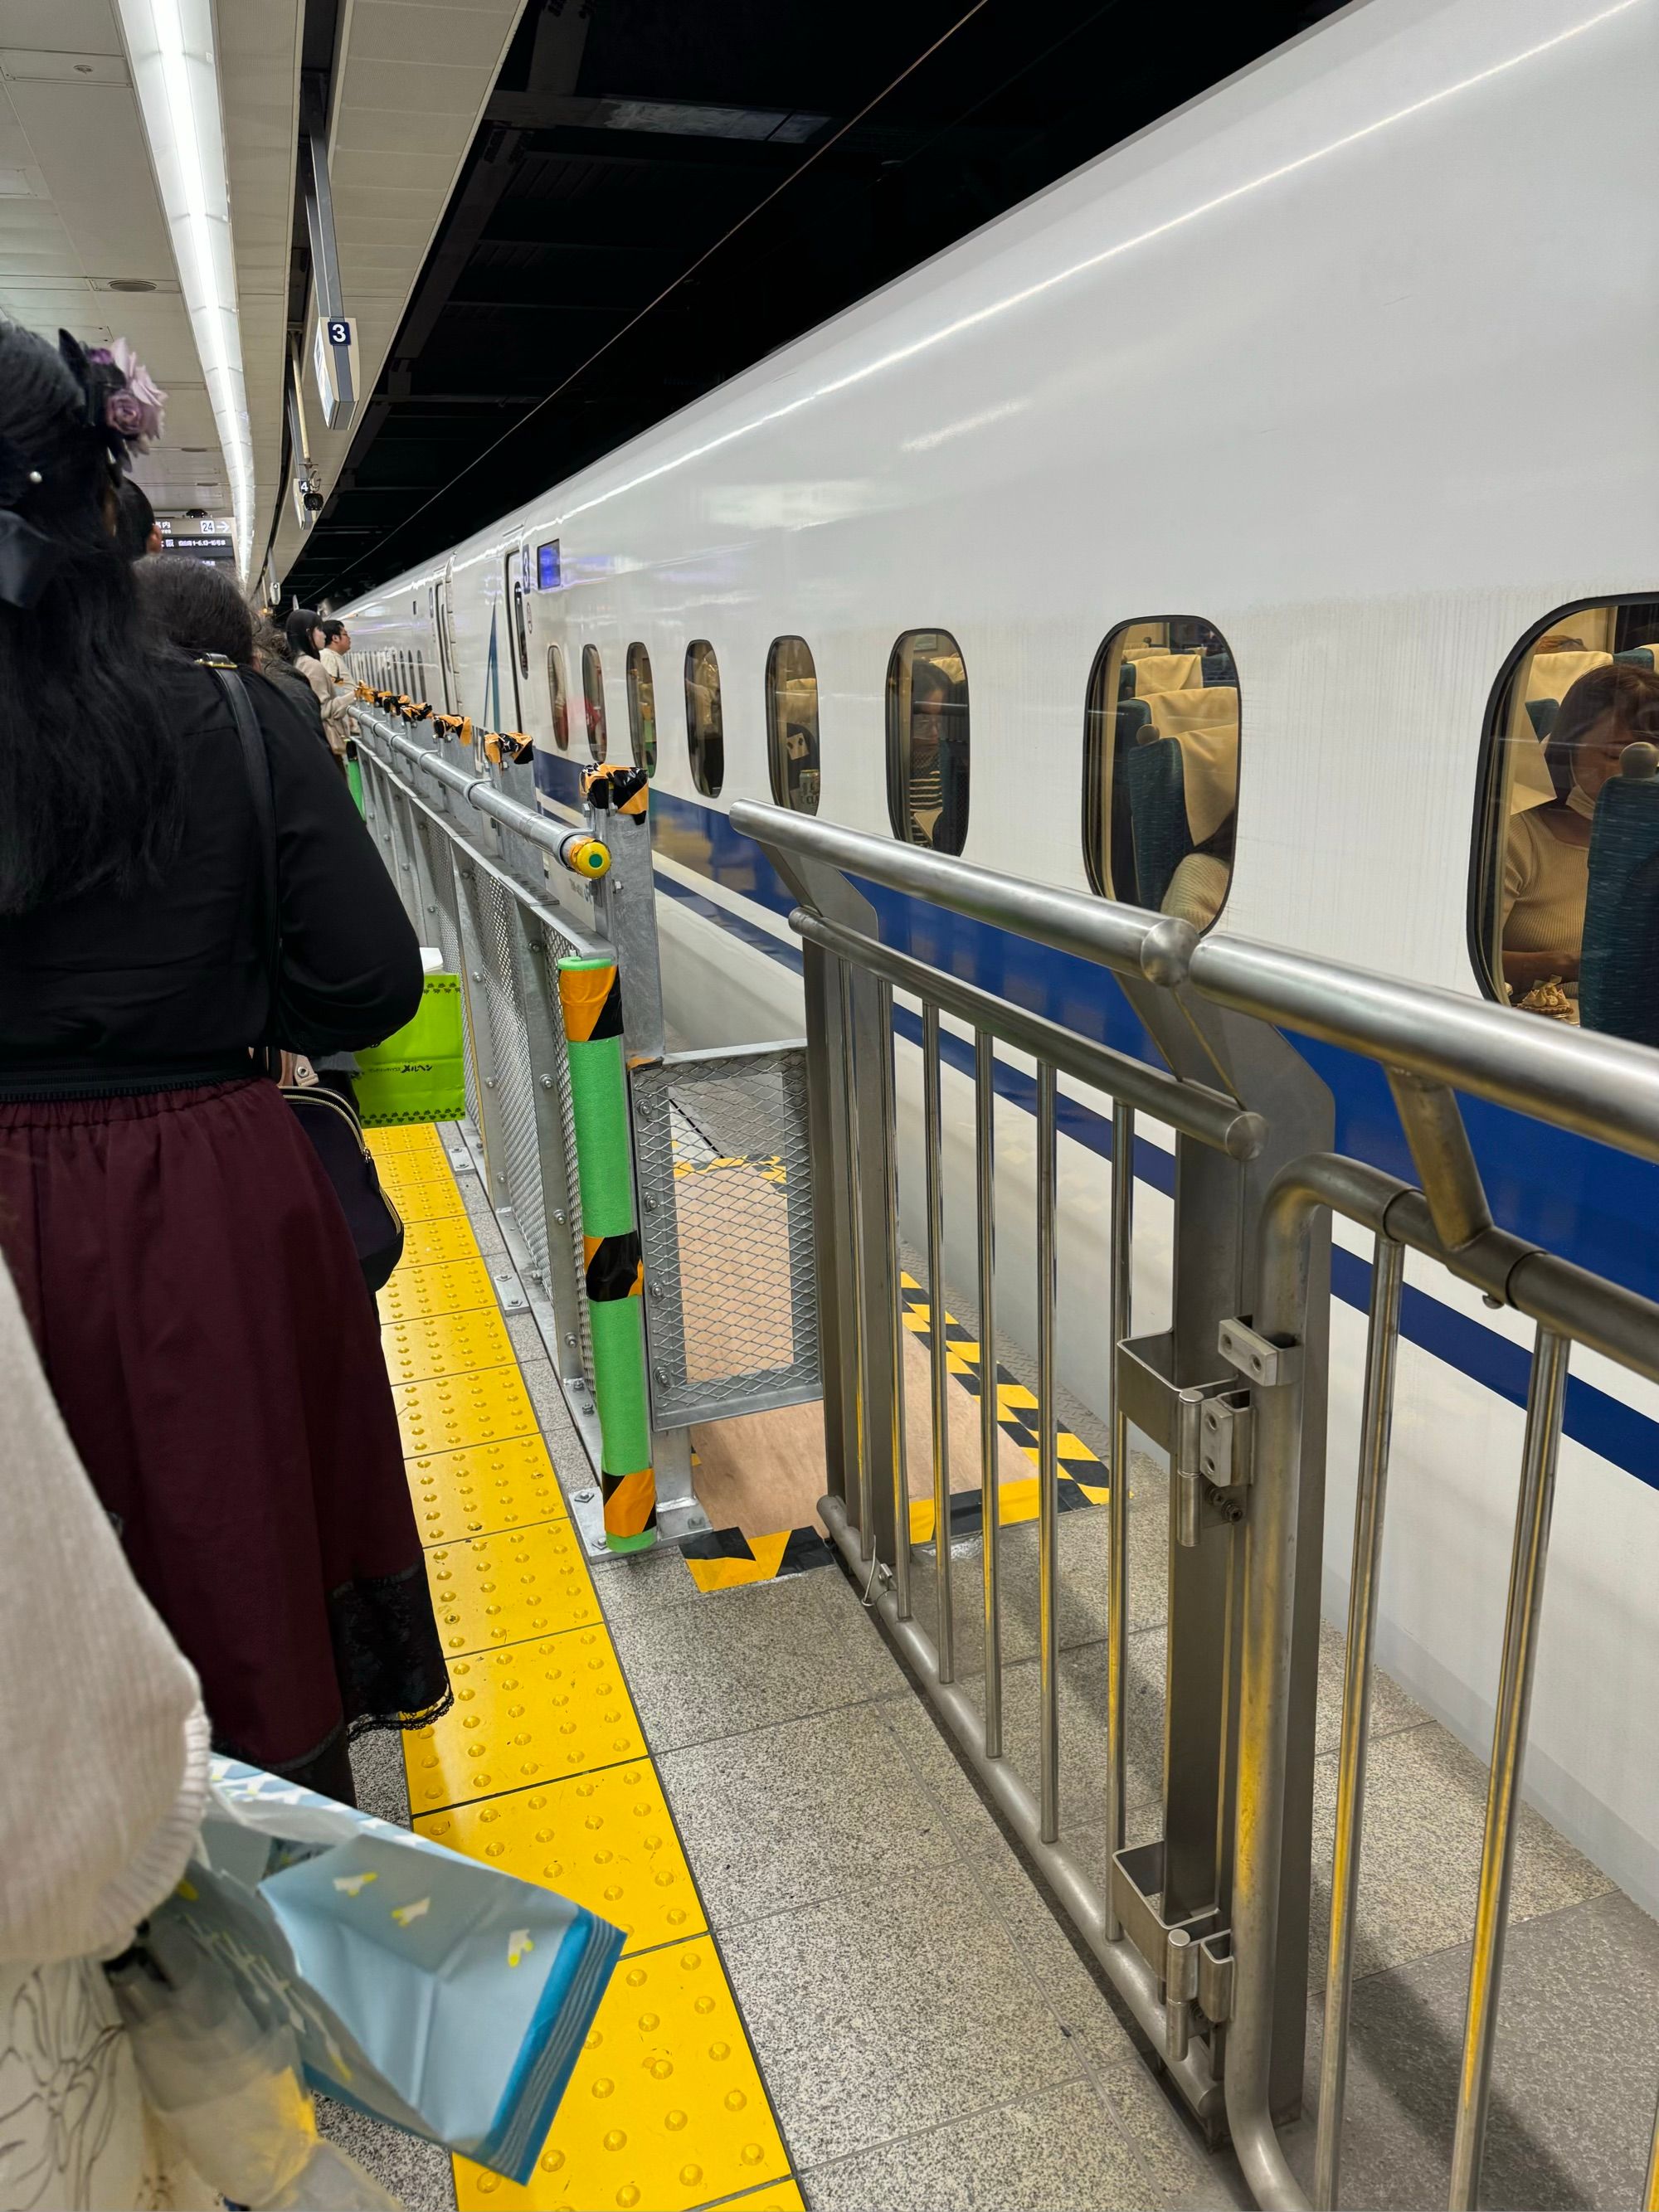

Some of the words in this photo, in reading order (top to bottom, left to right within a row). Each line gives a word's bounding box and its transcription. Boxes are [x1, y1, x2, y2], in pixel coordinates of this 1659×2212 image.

[332, 323, 347, 343] 3
[300, 481, 309, 492] 4
[202, 523, 213, 532] 24
[401, 1064, 433, 1073] メルヘン
